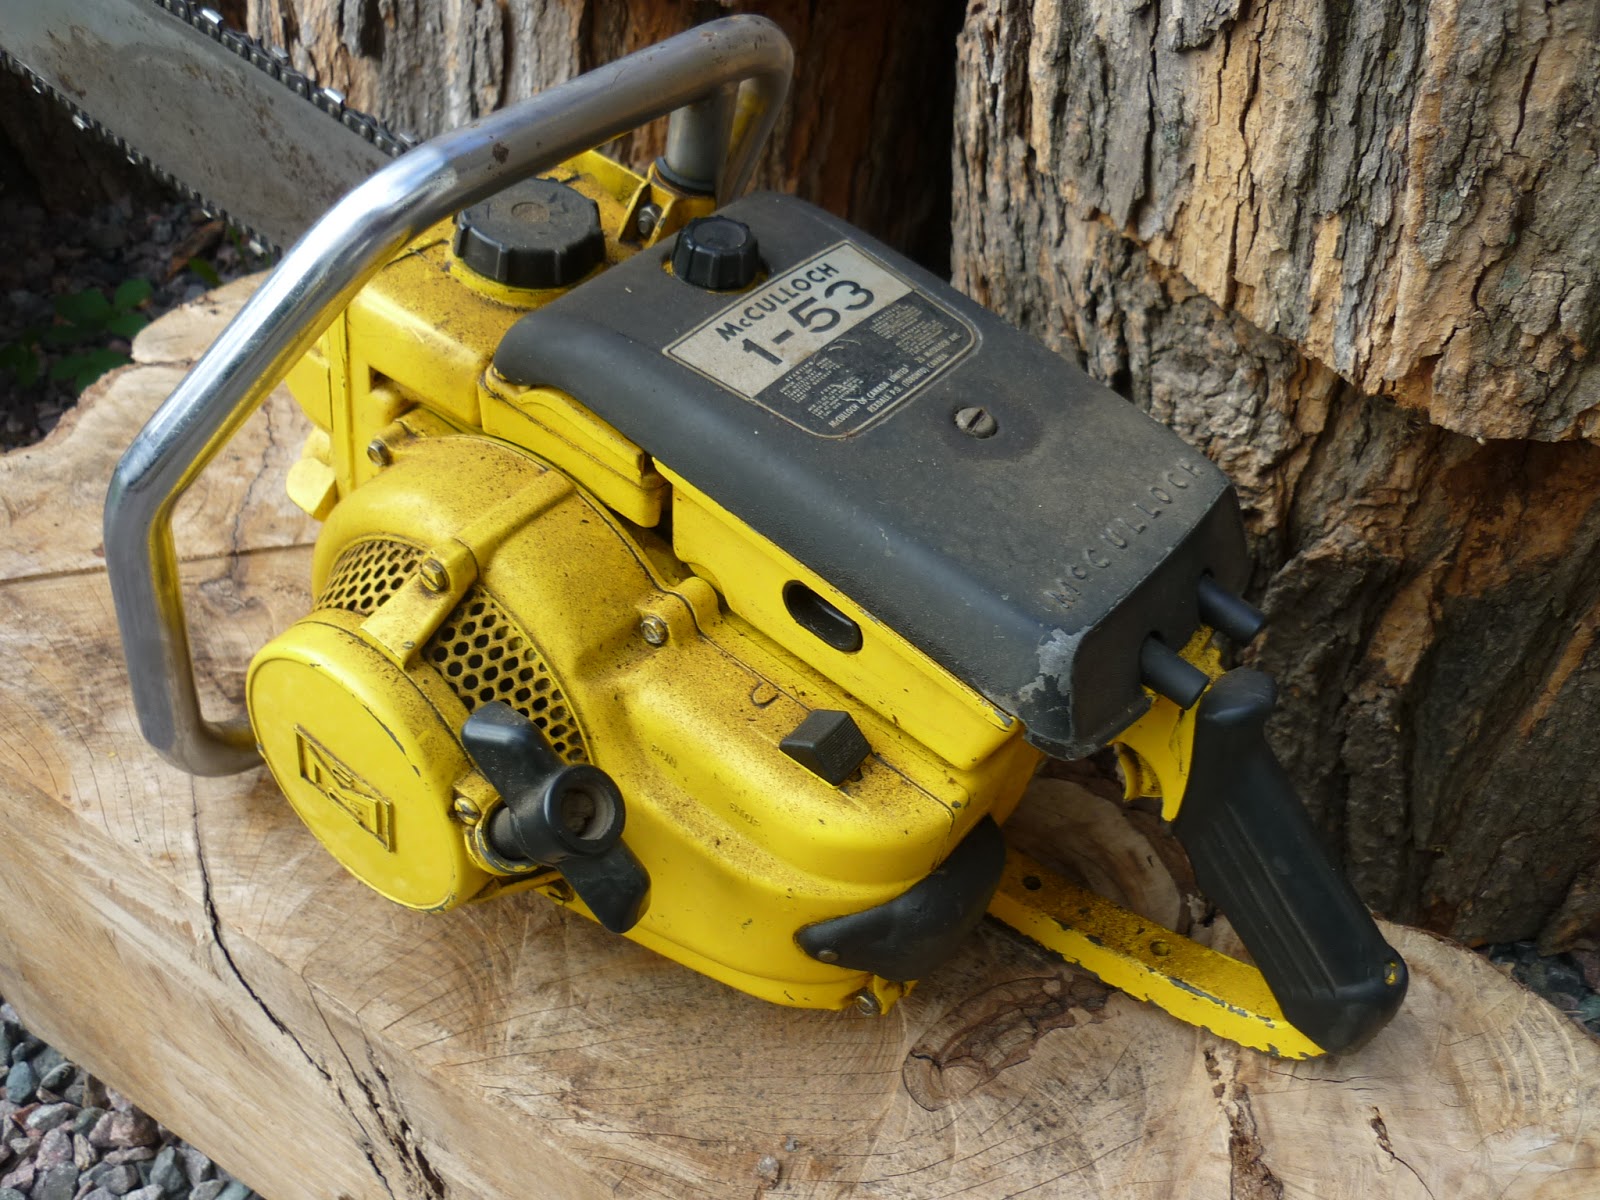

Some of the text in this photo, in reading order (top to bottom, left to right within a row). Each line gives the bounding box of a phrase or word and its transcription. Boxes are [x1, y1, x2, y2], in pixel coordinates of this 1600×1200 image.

[715, 262, 839, 342] McCULLOCH
[740, 280, 874, 367] 1-53
[829, 404, 859, 427] McCULLOCH
[865, 380, 890, 398] CANADA
[865, 393, 892, 412] REXDALE
[899, 366, 930, 387] (TORONTO)
[925, 352, 949, 368] CANADA
